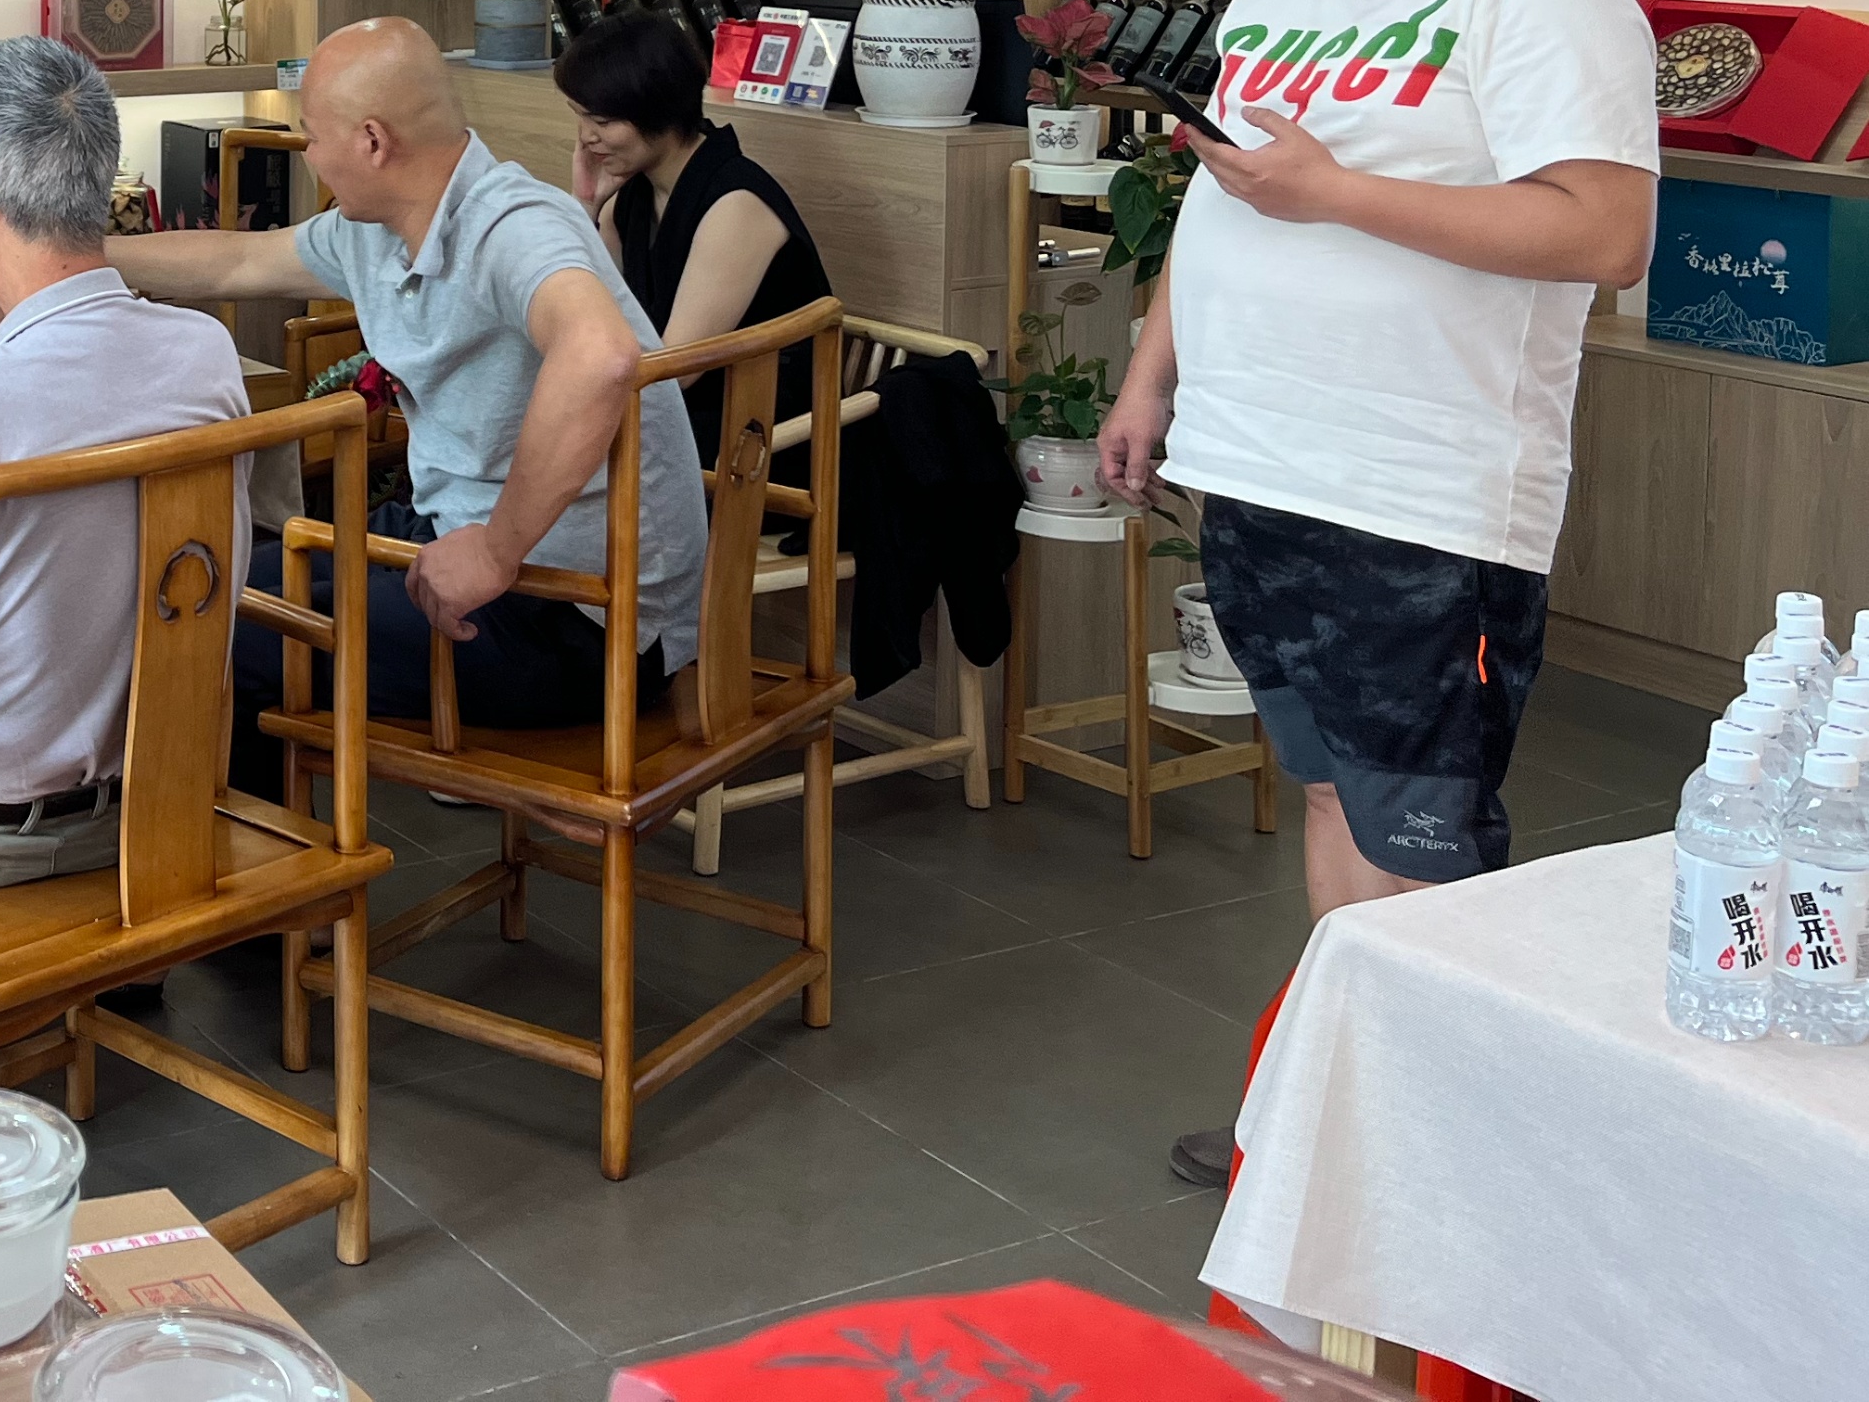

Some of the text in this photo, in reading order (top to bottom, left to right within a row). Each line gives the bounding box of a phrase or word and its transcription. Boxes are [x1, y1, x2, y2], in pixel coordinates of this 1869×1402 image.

[1684, 244, 1791, 295] 香格里拉松茸
[1722, 893, 1763, 969] 喝开水
[1789, 892, 1839, 969] 喝开水
